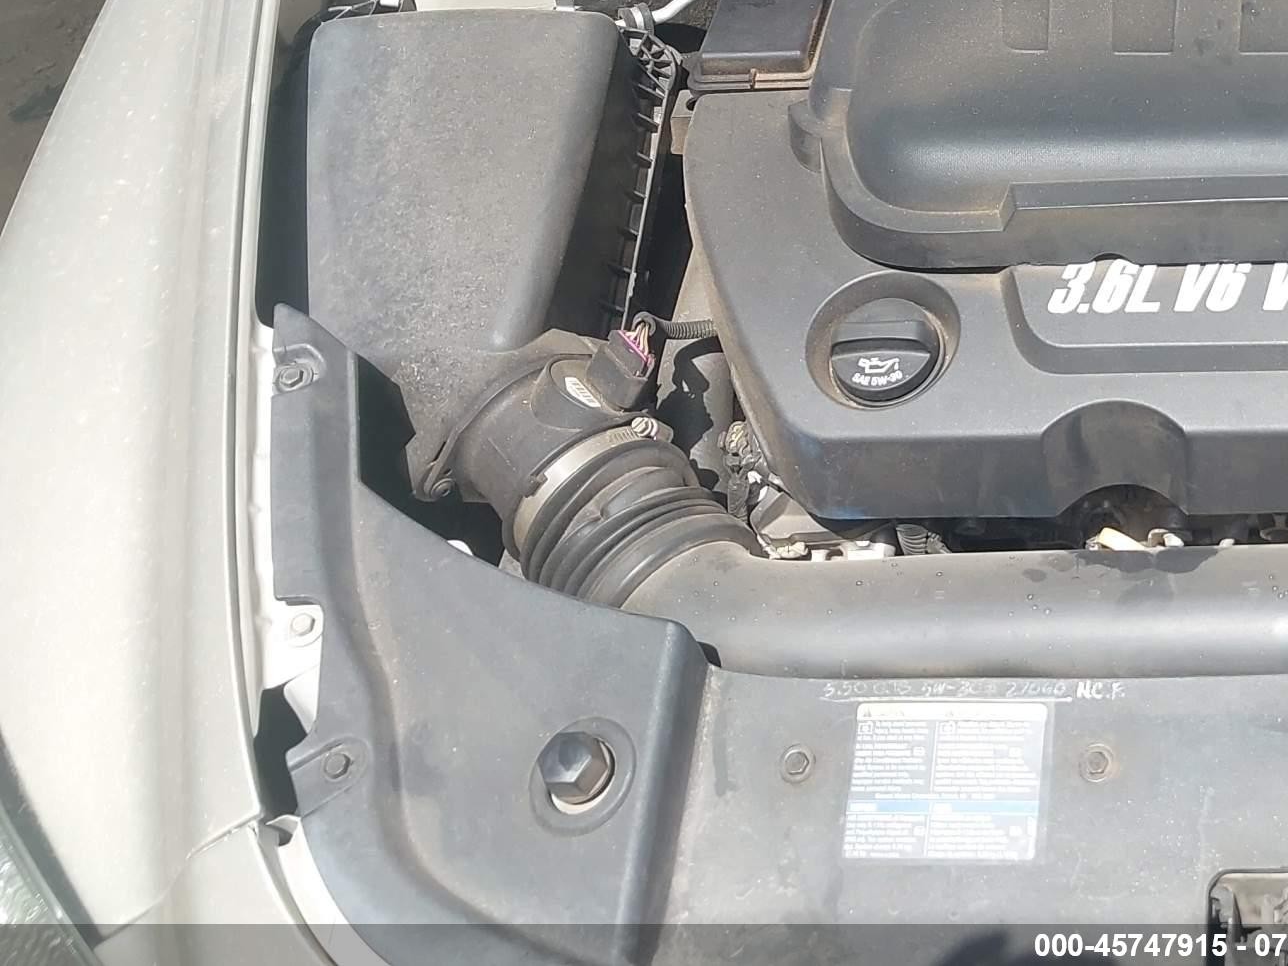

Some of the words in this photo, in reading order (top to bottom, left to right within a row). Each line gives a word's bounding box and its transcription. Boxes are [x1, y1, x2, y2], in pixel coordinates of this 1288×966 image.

[1047, 258, 1161, 314] 3.6L
[1173, 262, 1252, 313] V6
[851, 372, 871, 386] SAE
[870, 370, 903, 386] 5W-30
